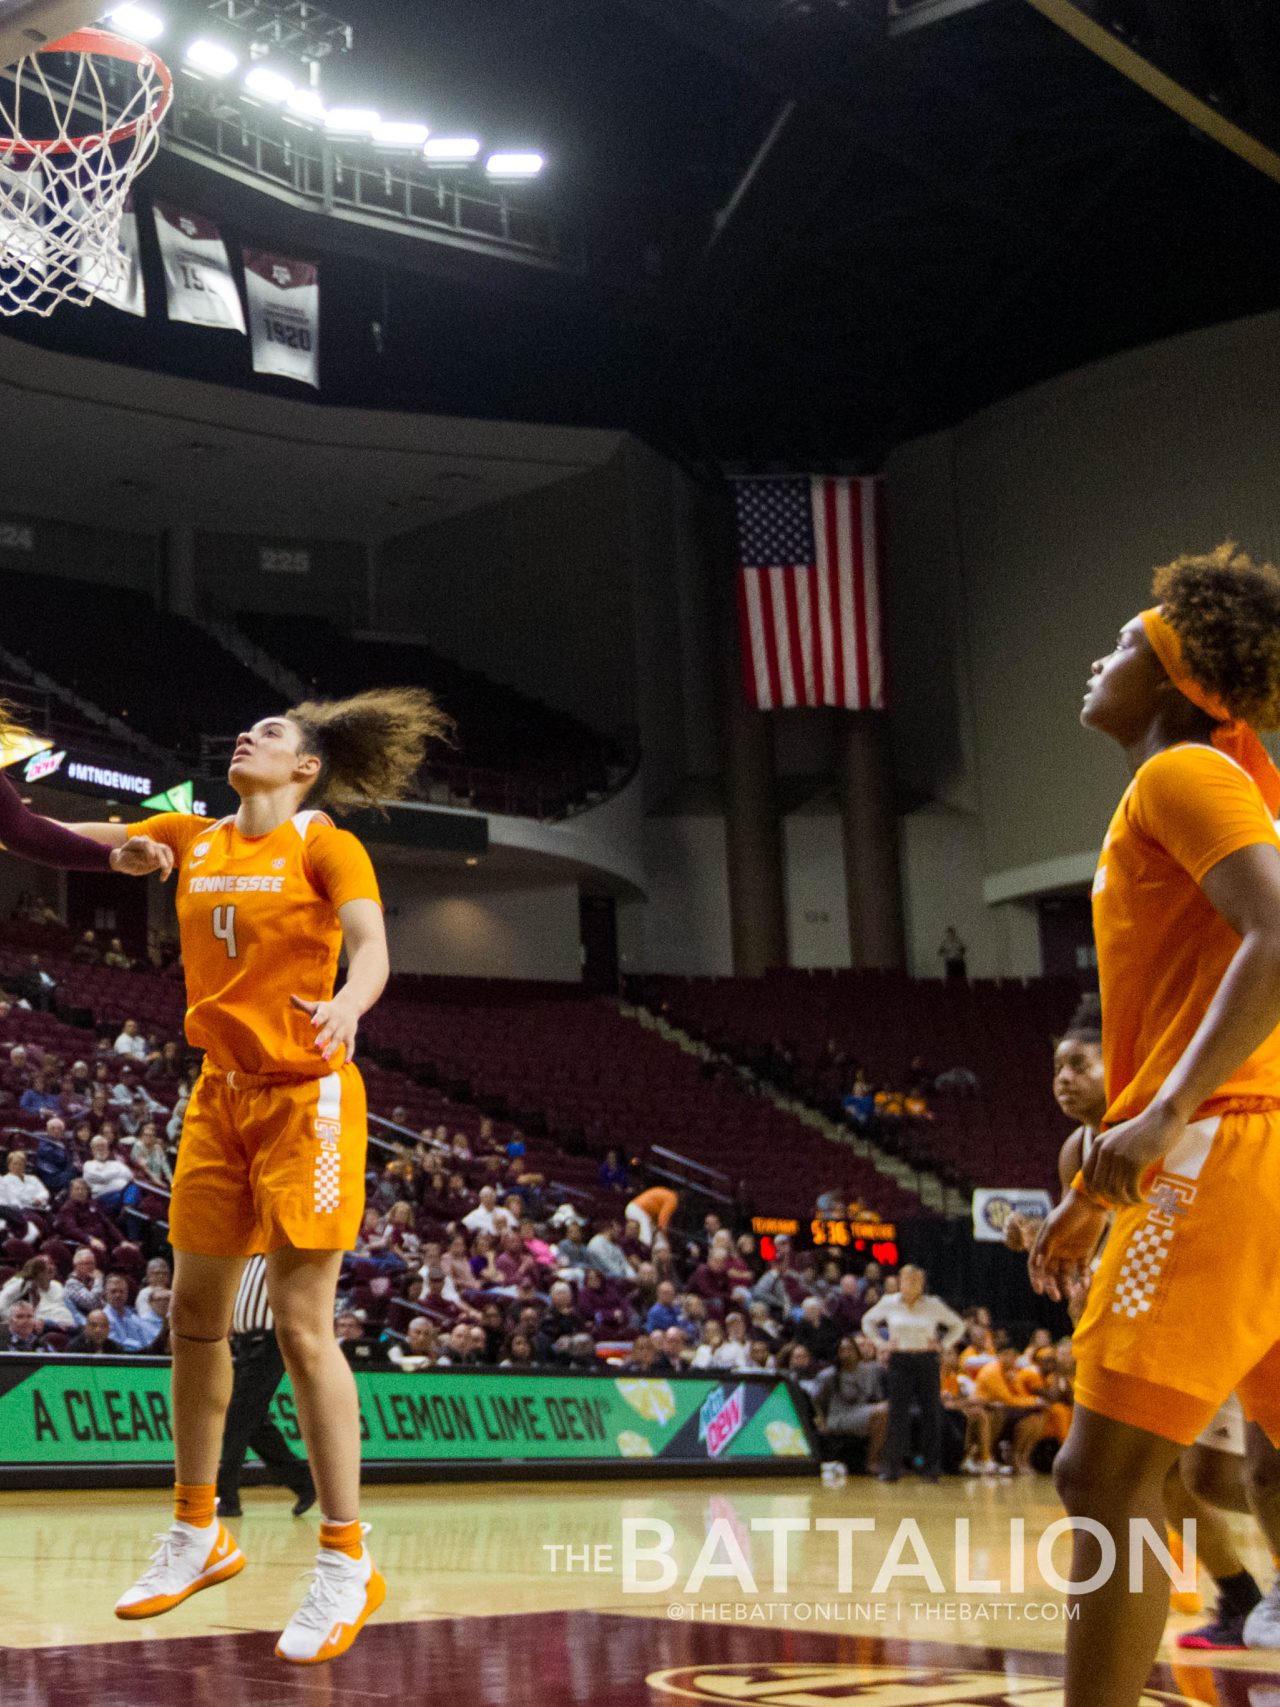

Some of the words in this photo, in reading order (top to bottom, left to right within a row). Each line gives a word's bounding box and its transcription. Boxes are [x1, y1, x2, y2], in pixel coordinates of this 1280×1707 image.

[68, 763, 151, 795] #MTNDEWICE
[189, 875, 285, 894] TENNESSEE
[212, 904, 238, 959] 4
[35, 1388, 59, 1441] A
[64, 1389, 173, 1441] CLEAR
[373, 1393, 477, 1441] LEMON
[477, 1396, 546, 1441] LIME
